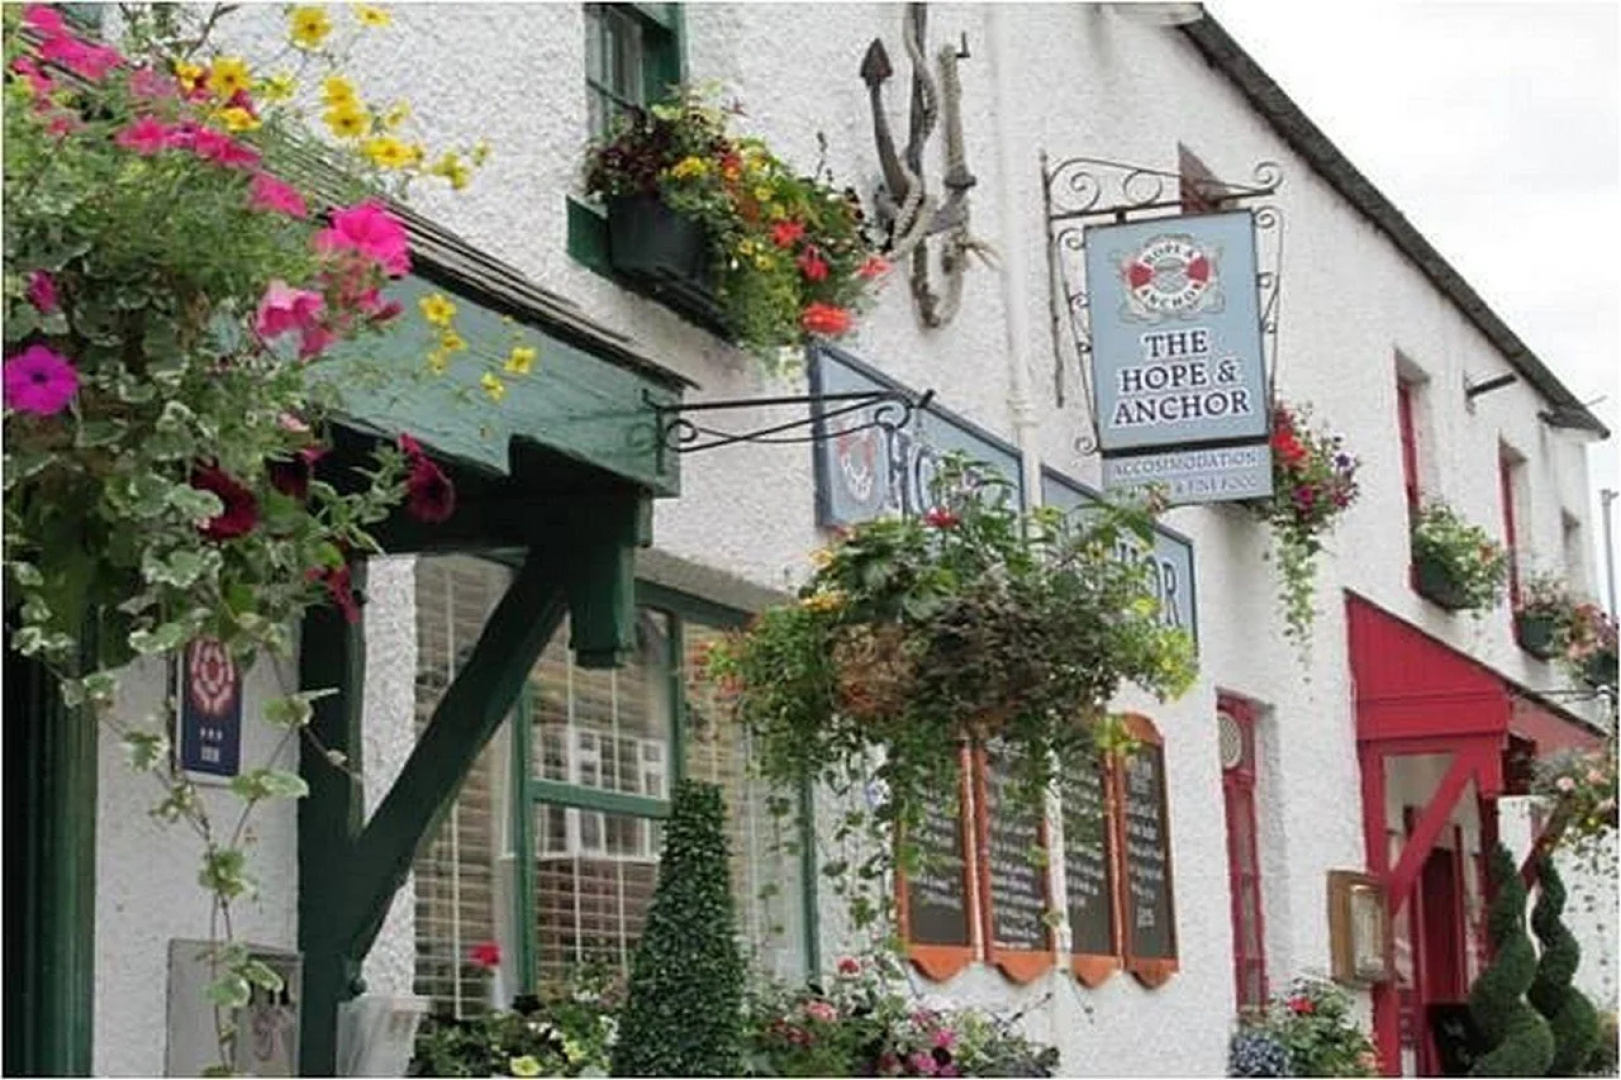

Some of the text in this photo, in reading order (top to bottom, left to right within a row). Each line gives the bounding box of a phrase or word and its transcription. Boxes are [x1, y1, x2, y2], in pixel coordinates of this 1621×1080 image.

[1144, 330, 1208, 358] THE
[1121, 360, 1238, 392] HOPE &
[1113, 390, 1250, 425] ANCHOR
